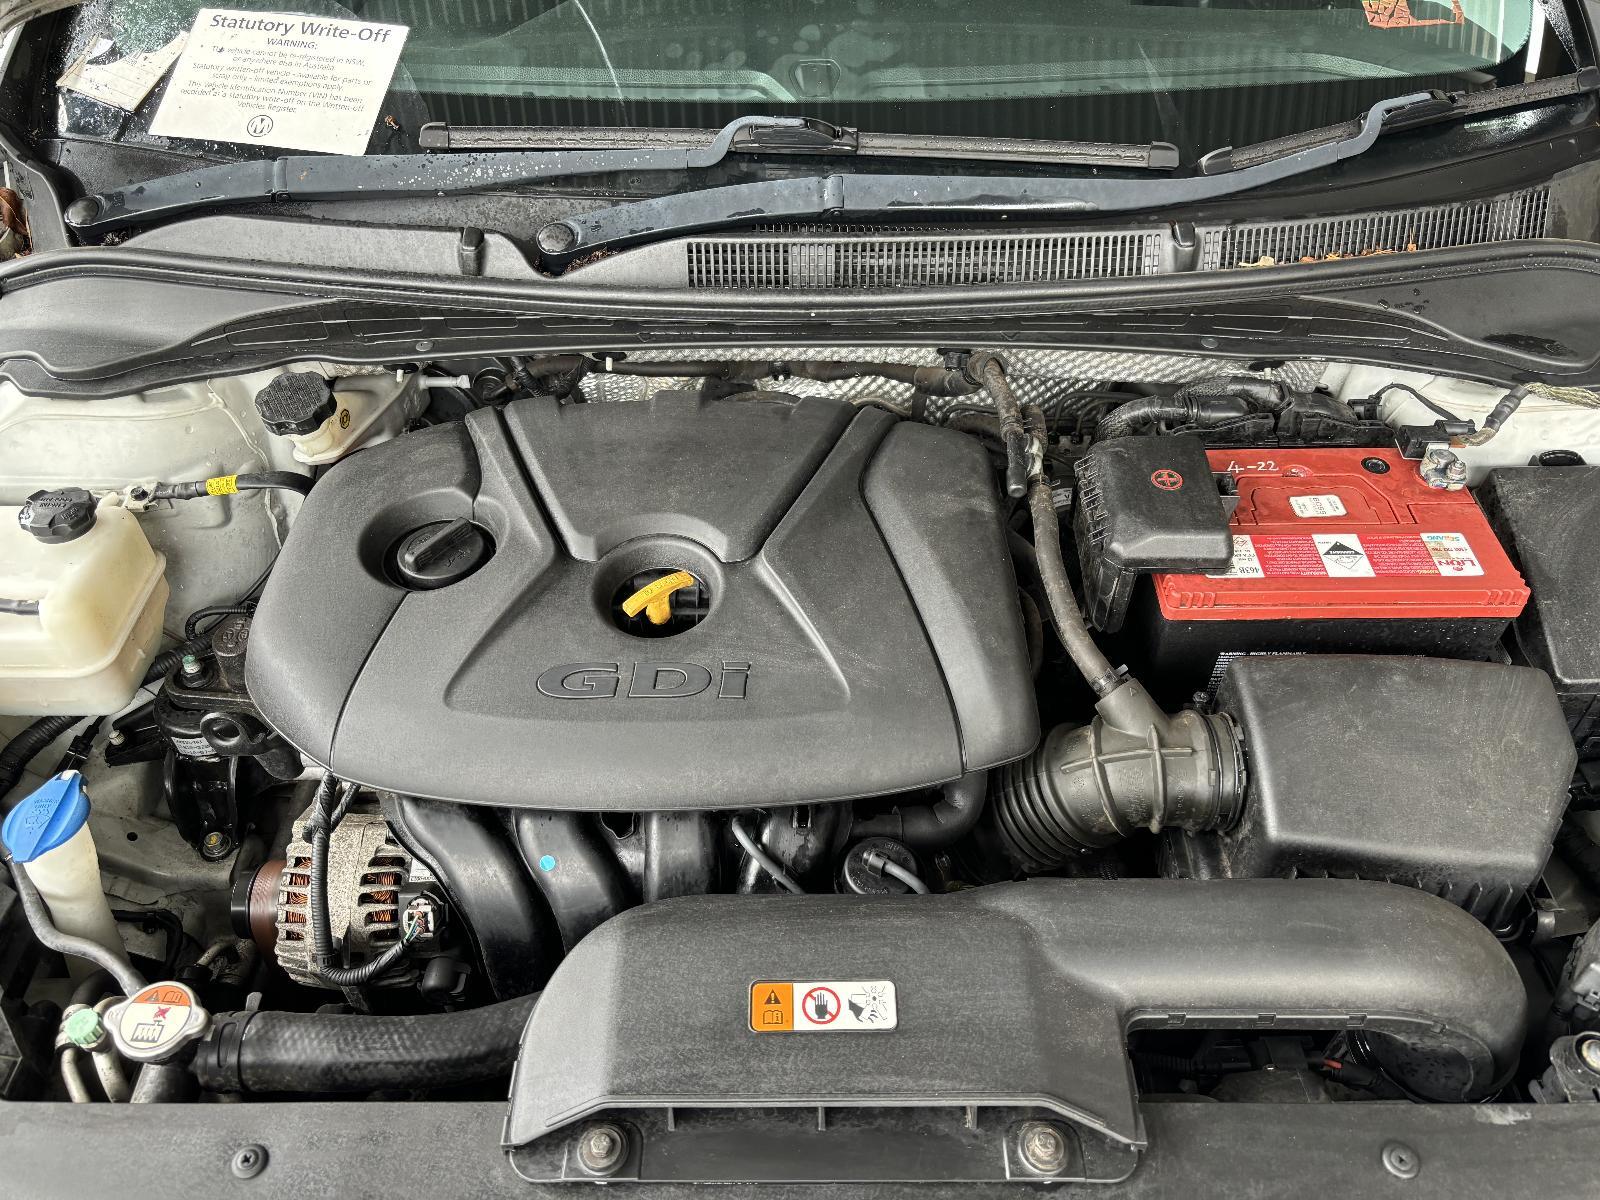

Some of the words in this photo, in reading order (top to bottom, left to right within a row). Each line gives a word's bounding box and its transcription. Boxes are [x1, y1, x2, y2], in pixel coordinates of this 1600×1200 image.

[210, 14, 295, 36] Statutory
[301, 21, 392, 43] Write-Off
[267, 38, 318, 50] WARNING:
[192, 62, 225, 72] Statutory
[278, 87, 307, 97] Number
[535, 660, 753, 700] GDi
